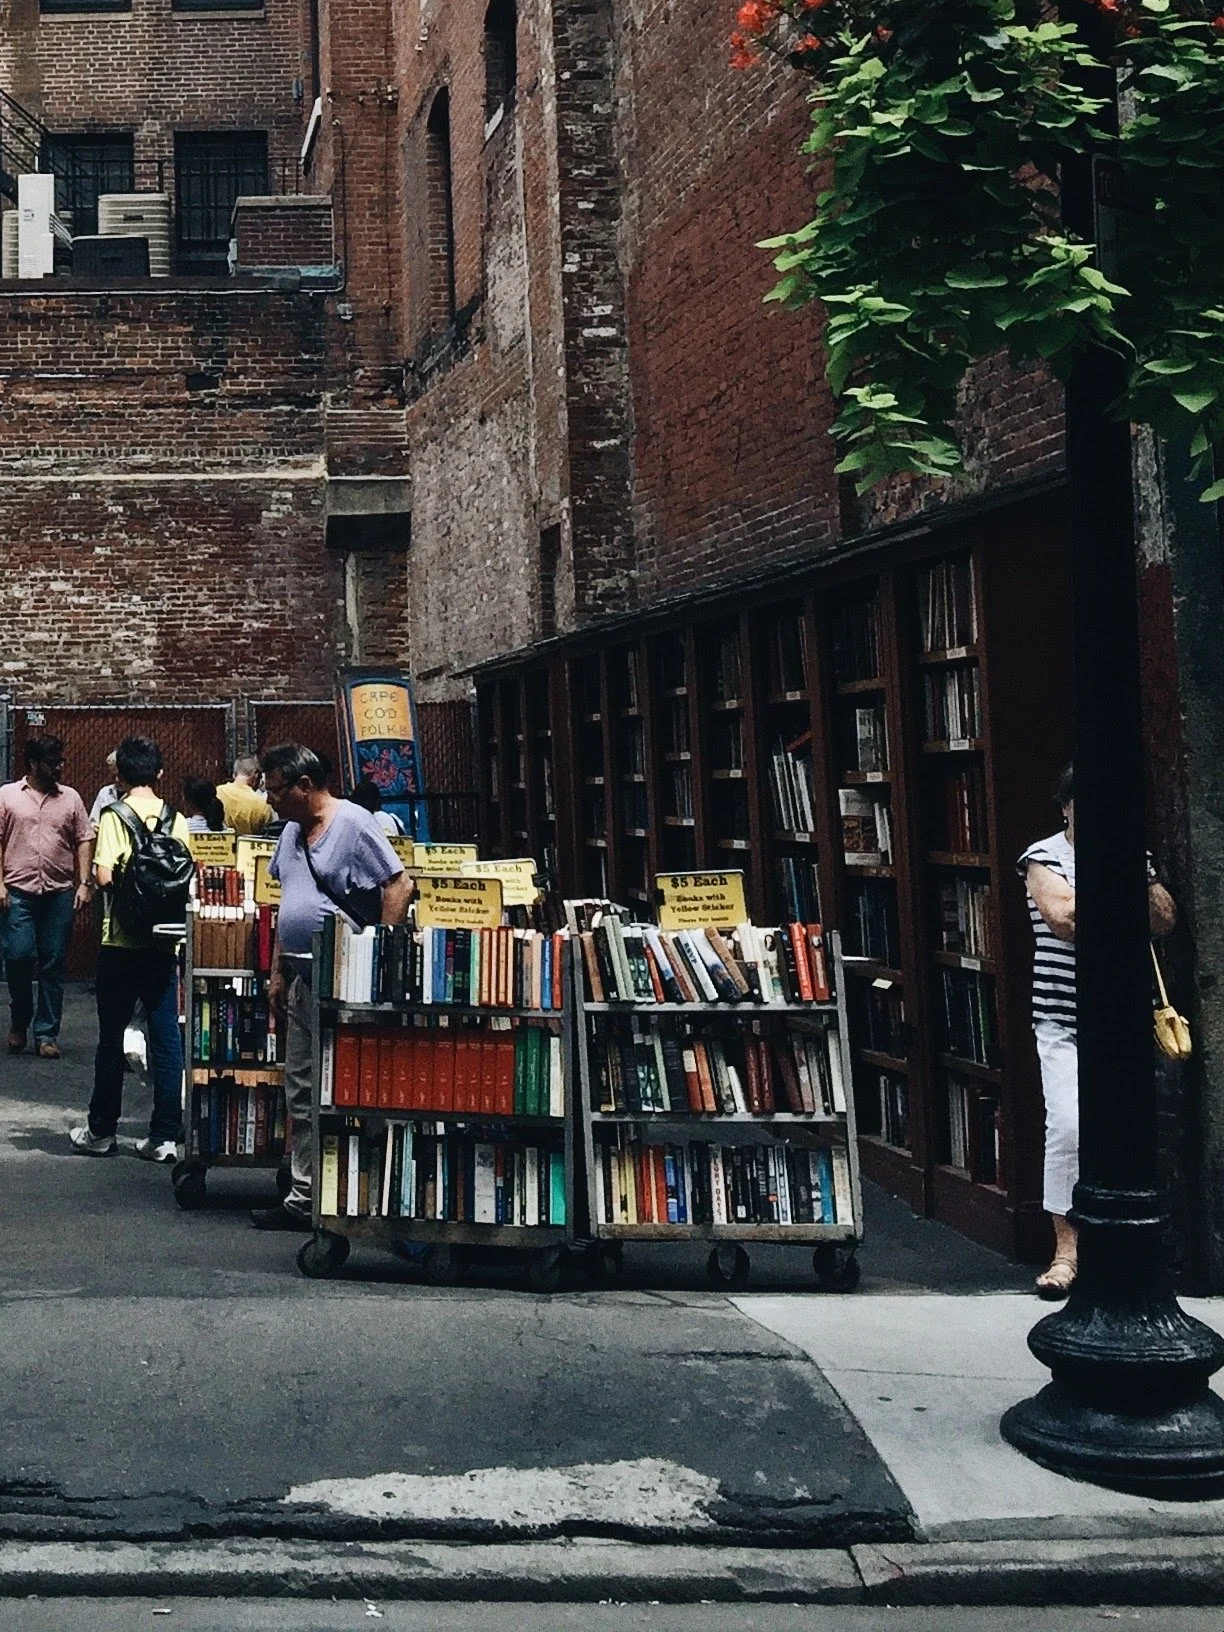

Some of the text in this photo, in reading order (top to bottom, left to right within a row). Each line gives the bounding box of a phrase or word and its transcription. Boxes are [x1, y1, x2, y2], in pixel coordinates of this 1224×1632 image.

[360, 690, 399, 704] CAPE
[364, 707, 398, 720] COD
[441, 846, 466, 855] Each
[431, 877, 486, 891] $5 Each
[670, 874, 728, 889] $5 Each
[464, 896, 483, 905] with
[706, 893, 726, 901] with
[428, 904, 457, 913] Yellow
[670, 903, 734, 913] Yellow Sticker
